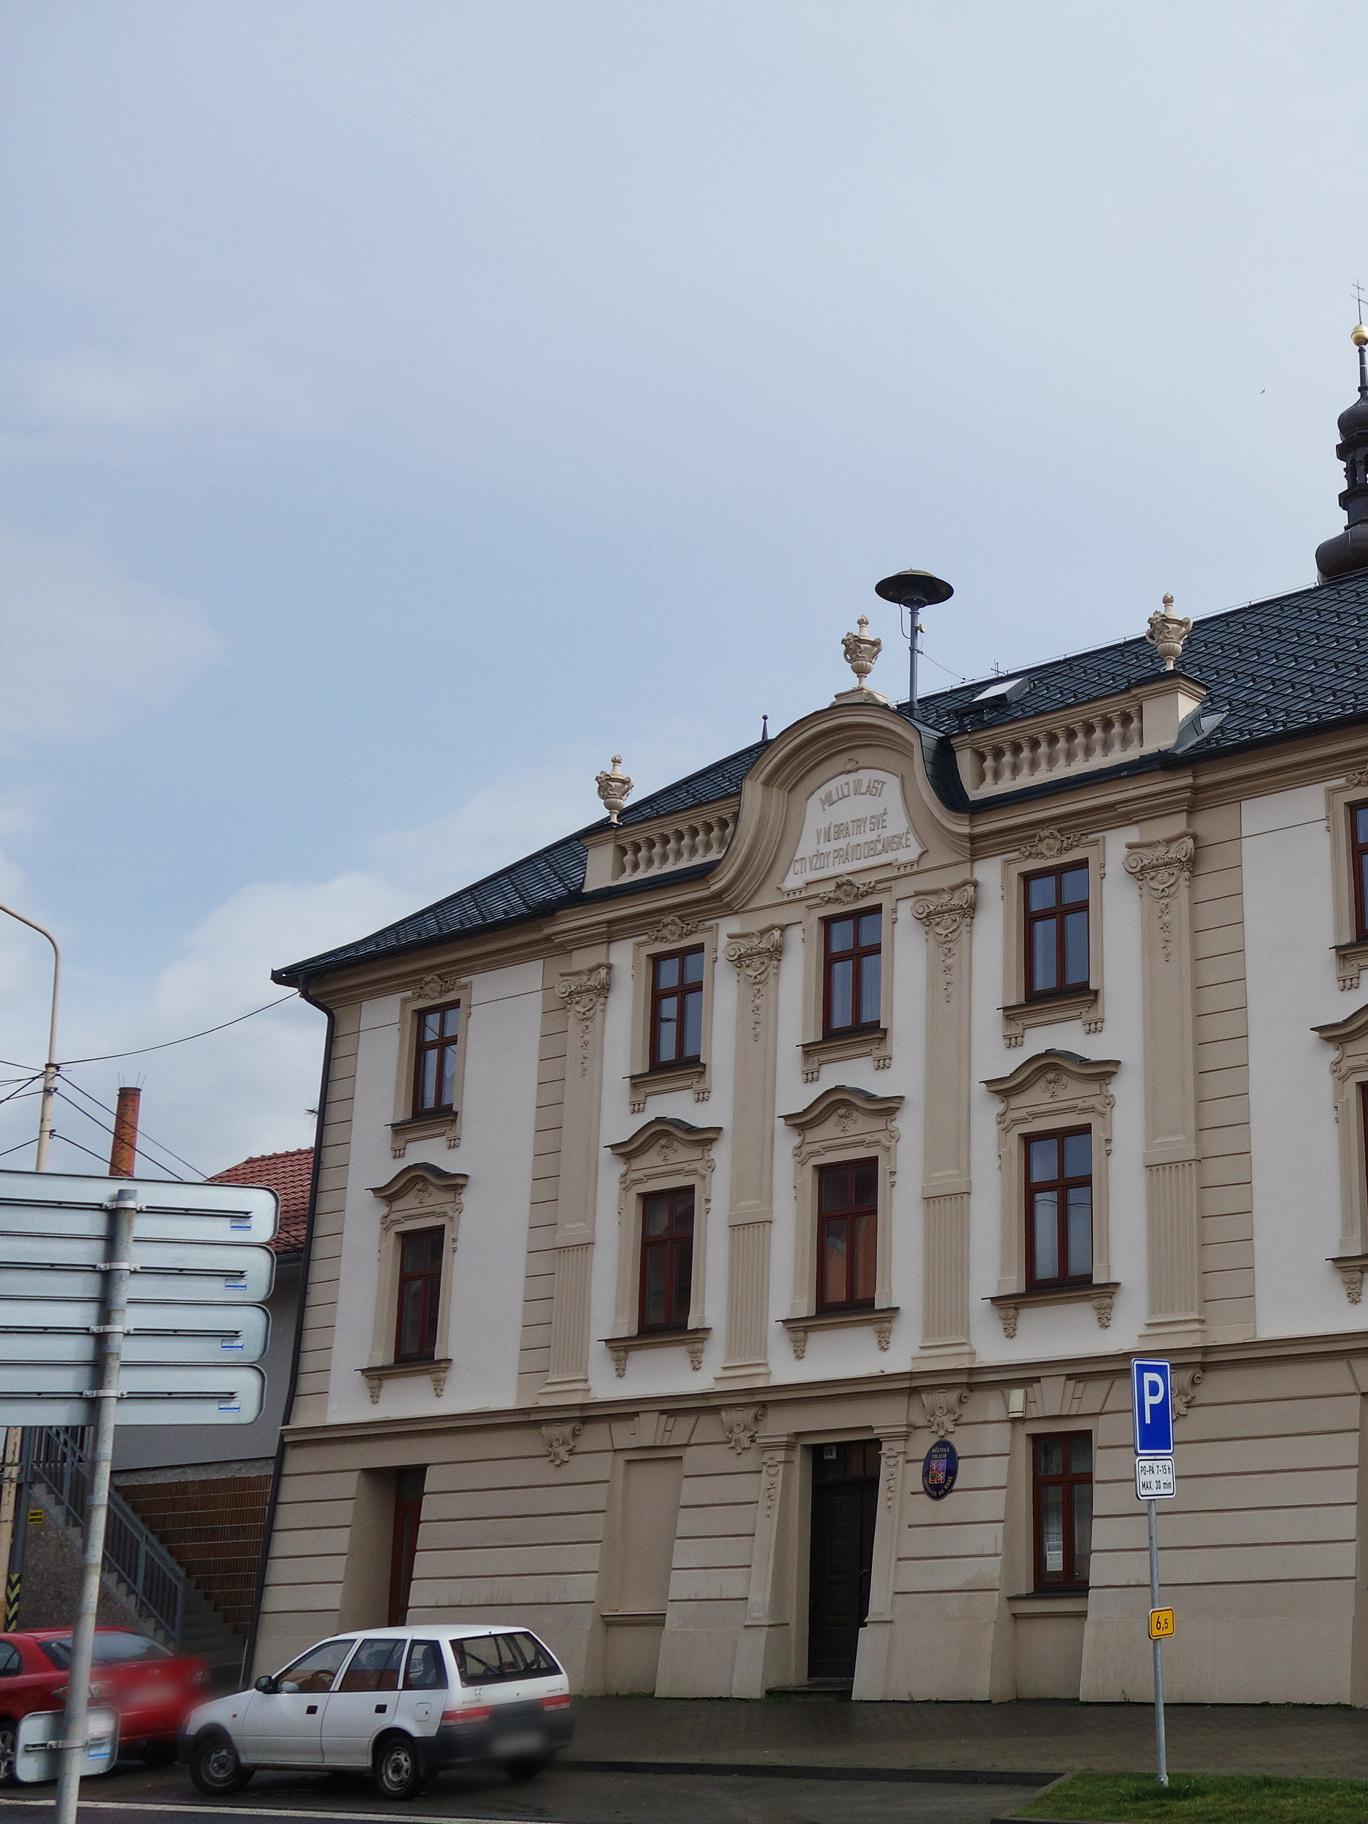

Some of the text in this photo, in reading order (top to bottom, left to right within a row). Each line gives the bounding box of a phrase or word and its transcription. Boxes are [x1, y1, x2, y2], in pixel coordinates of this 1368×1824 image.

[853, 779, 887, 798] VLAST
[816, 828, 822, 844] V
[833, 817, 868, 841] BRATRY
[869, 808, 888, 832] SVÉ
[793, 855, 807, 875] CTI
[832, 842, 862, 866] PRÁVO
[1143, 1372, 1164, 1424] P
[1140, 1463, 1155, 1475] PO-PÁ
[1155, 1479, 1162, 1490] 30
[1162, 1479, 1172, 1490] min
[1155, 1615, 1169, 1631] 6,5
[473, 1688, 483, 1696] CZ
